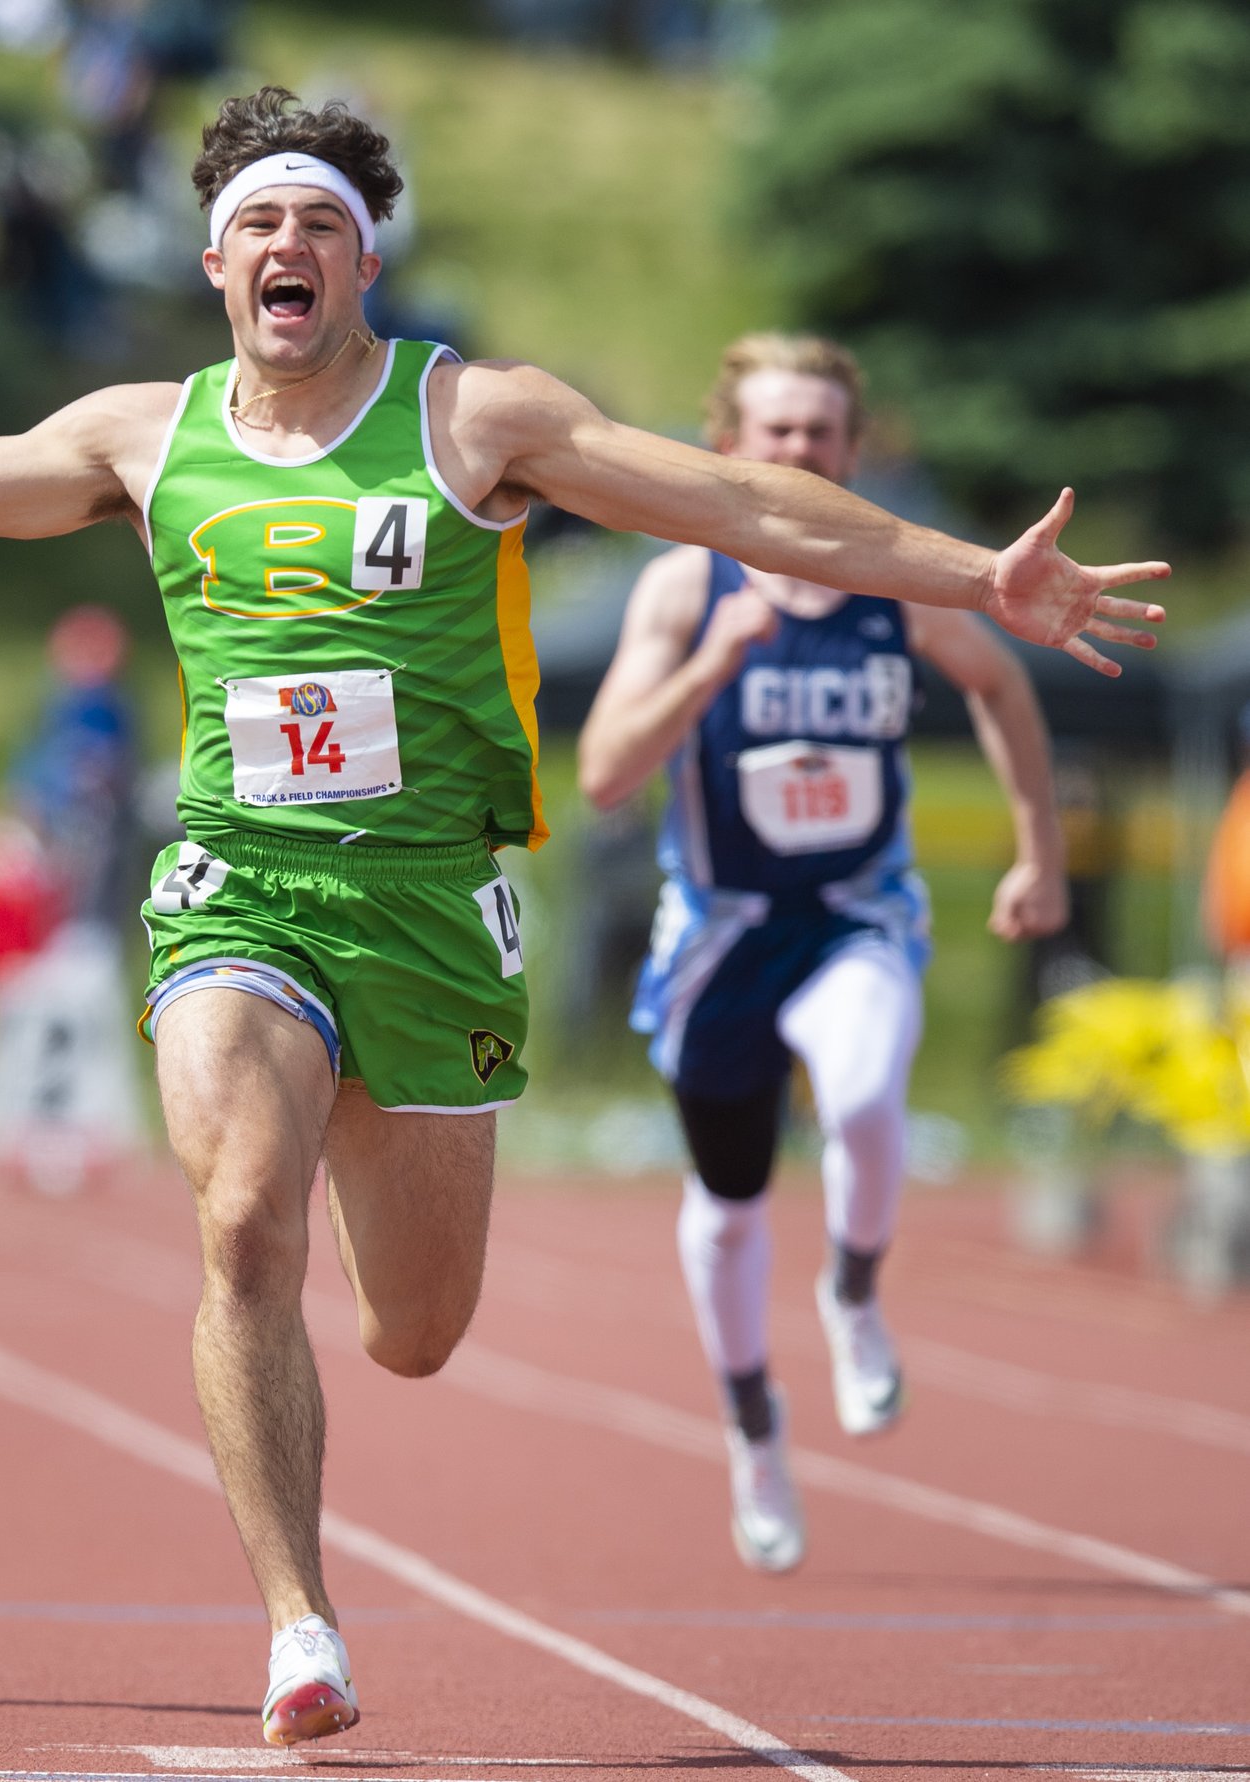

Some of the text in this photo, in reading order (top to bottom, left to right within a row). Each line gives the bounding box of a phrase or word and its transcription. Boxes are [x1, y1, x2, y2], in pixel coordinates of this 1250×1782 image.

[188, 497, 387, 620] B
[364, 504, 412, 585] 4
[279, 720, 347, 776] 14
[251, 794, 278, 803] TRACK
[289, 792, 313, 801] FIELD
[316, 784, 387, 799] CHAMPIONSHIPS
